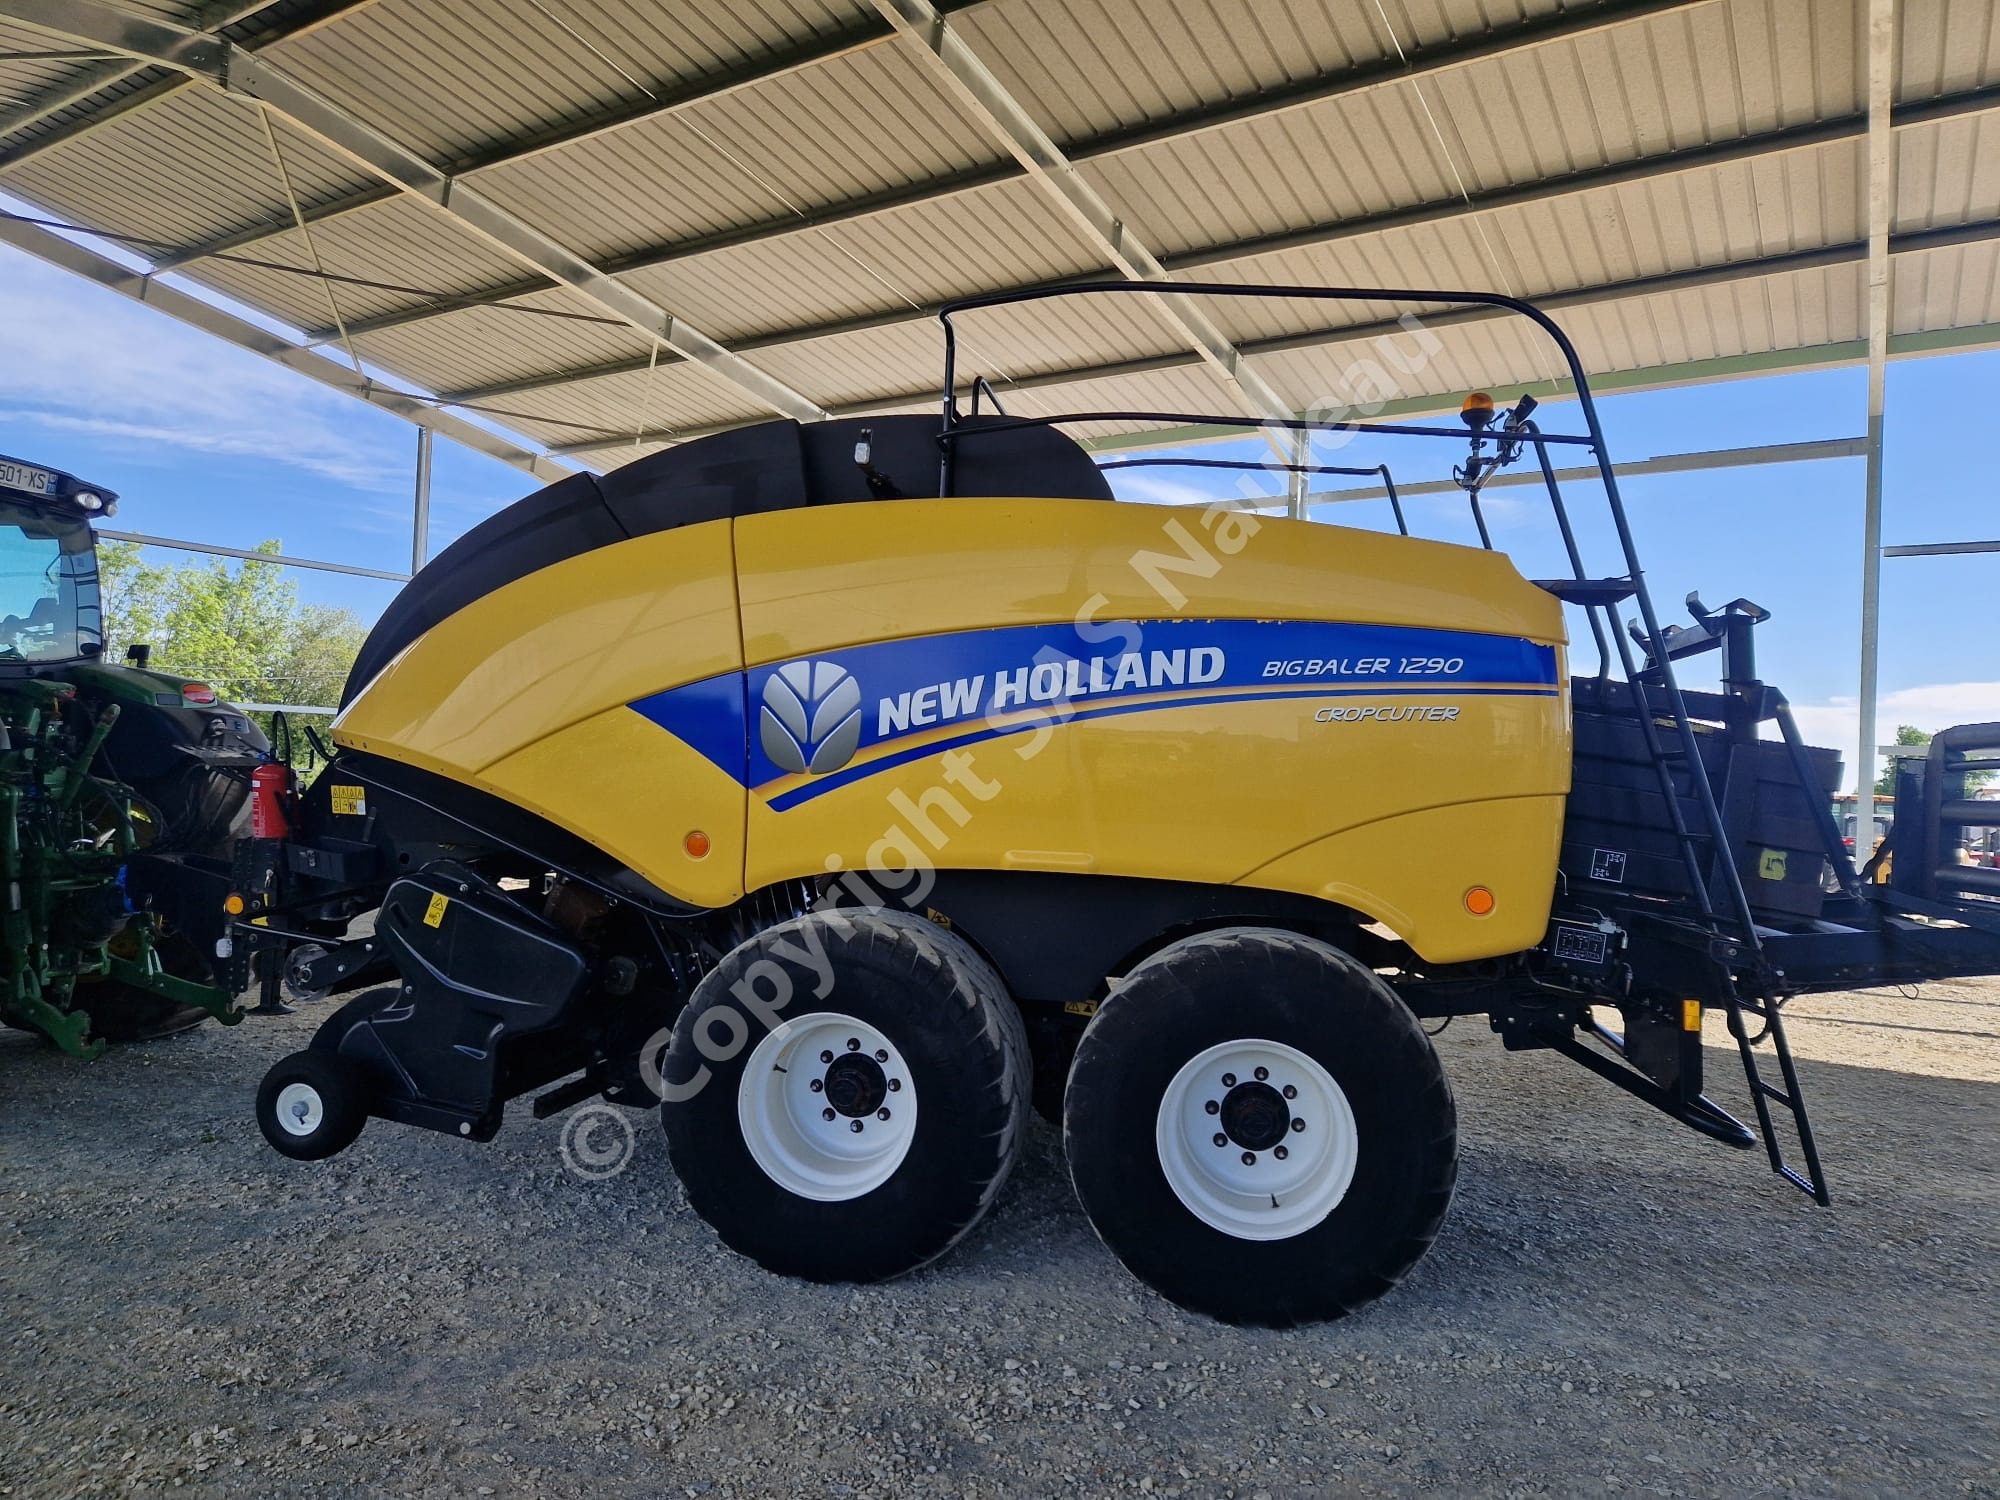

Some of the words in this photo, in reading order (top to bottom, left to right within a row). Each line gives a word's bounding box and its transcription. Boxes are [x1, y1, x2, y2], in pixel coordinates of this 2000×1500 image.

[1397, 657, 1464, 674] 1290
[878, 675, 985, 736] NEW
[994, 647, 1226, 709] HOLLAND
[1314, 706, 1461, 722] CROPCUTTER
